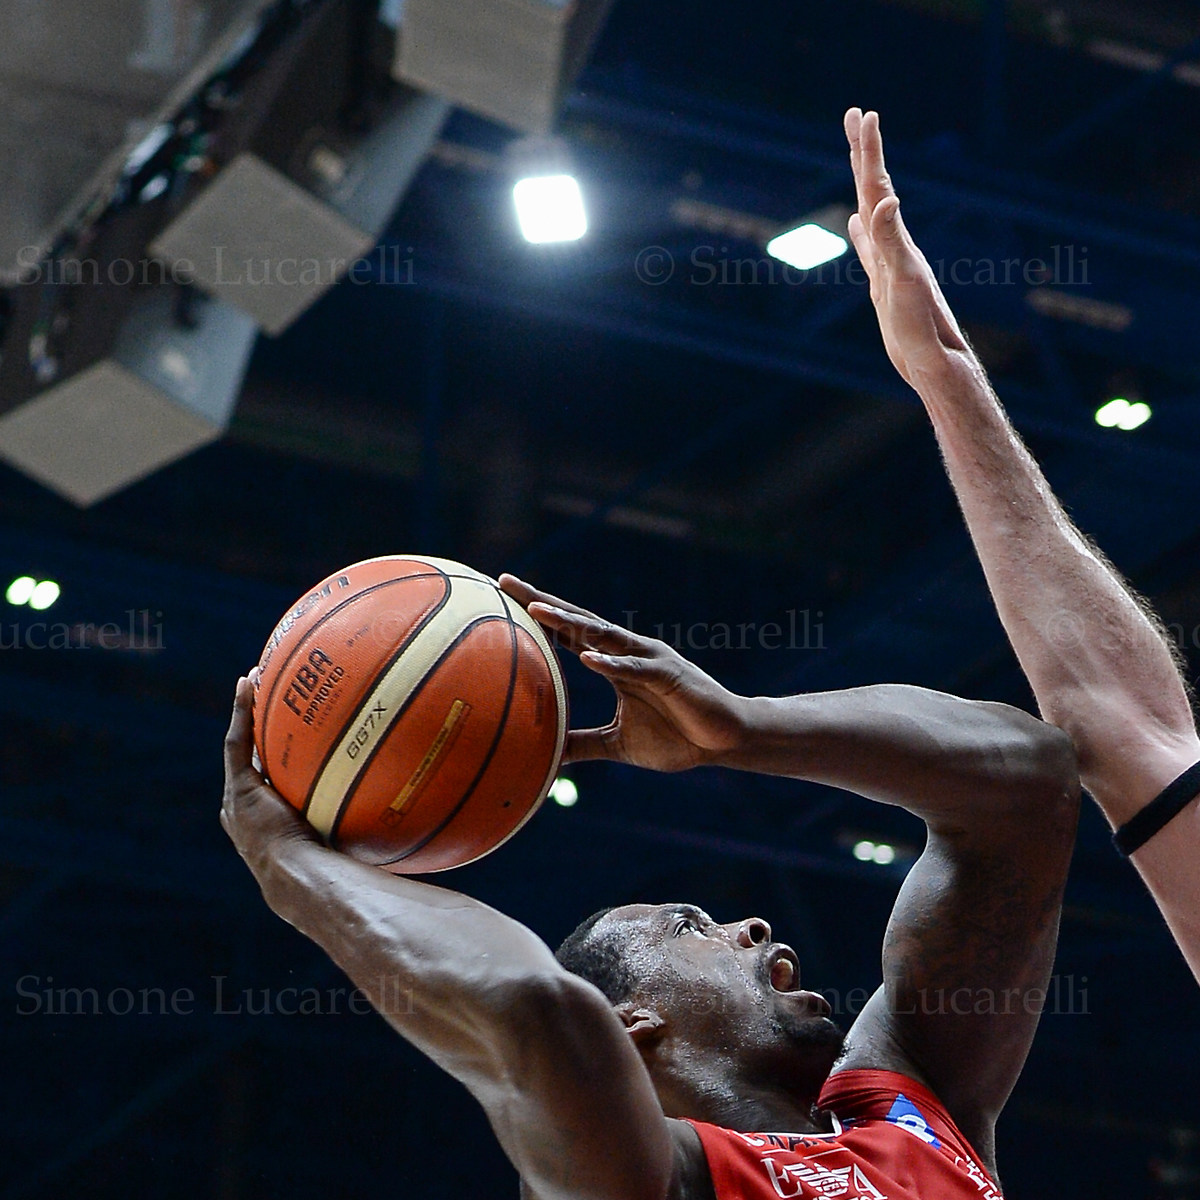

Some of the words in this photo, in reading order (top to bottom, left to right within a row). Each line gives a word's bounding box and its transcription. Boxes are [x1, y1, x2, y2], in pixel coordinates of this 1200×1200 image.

[283, 648, 333, 715] FIBA
[303, 666, 345, 726] APPROVED
[346, 700, 387, 760] GG7X
